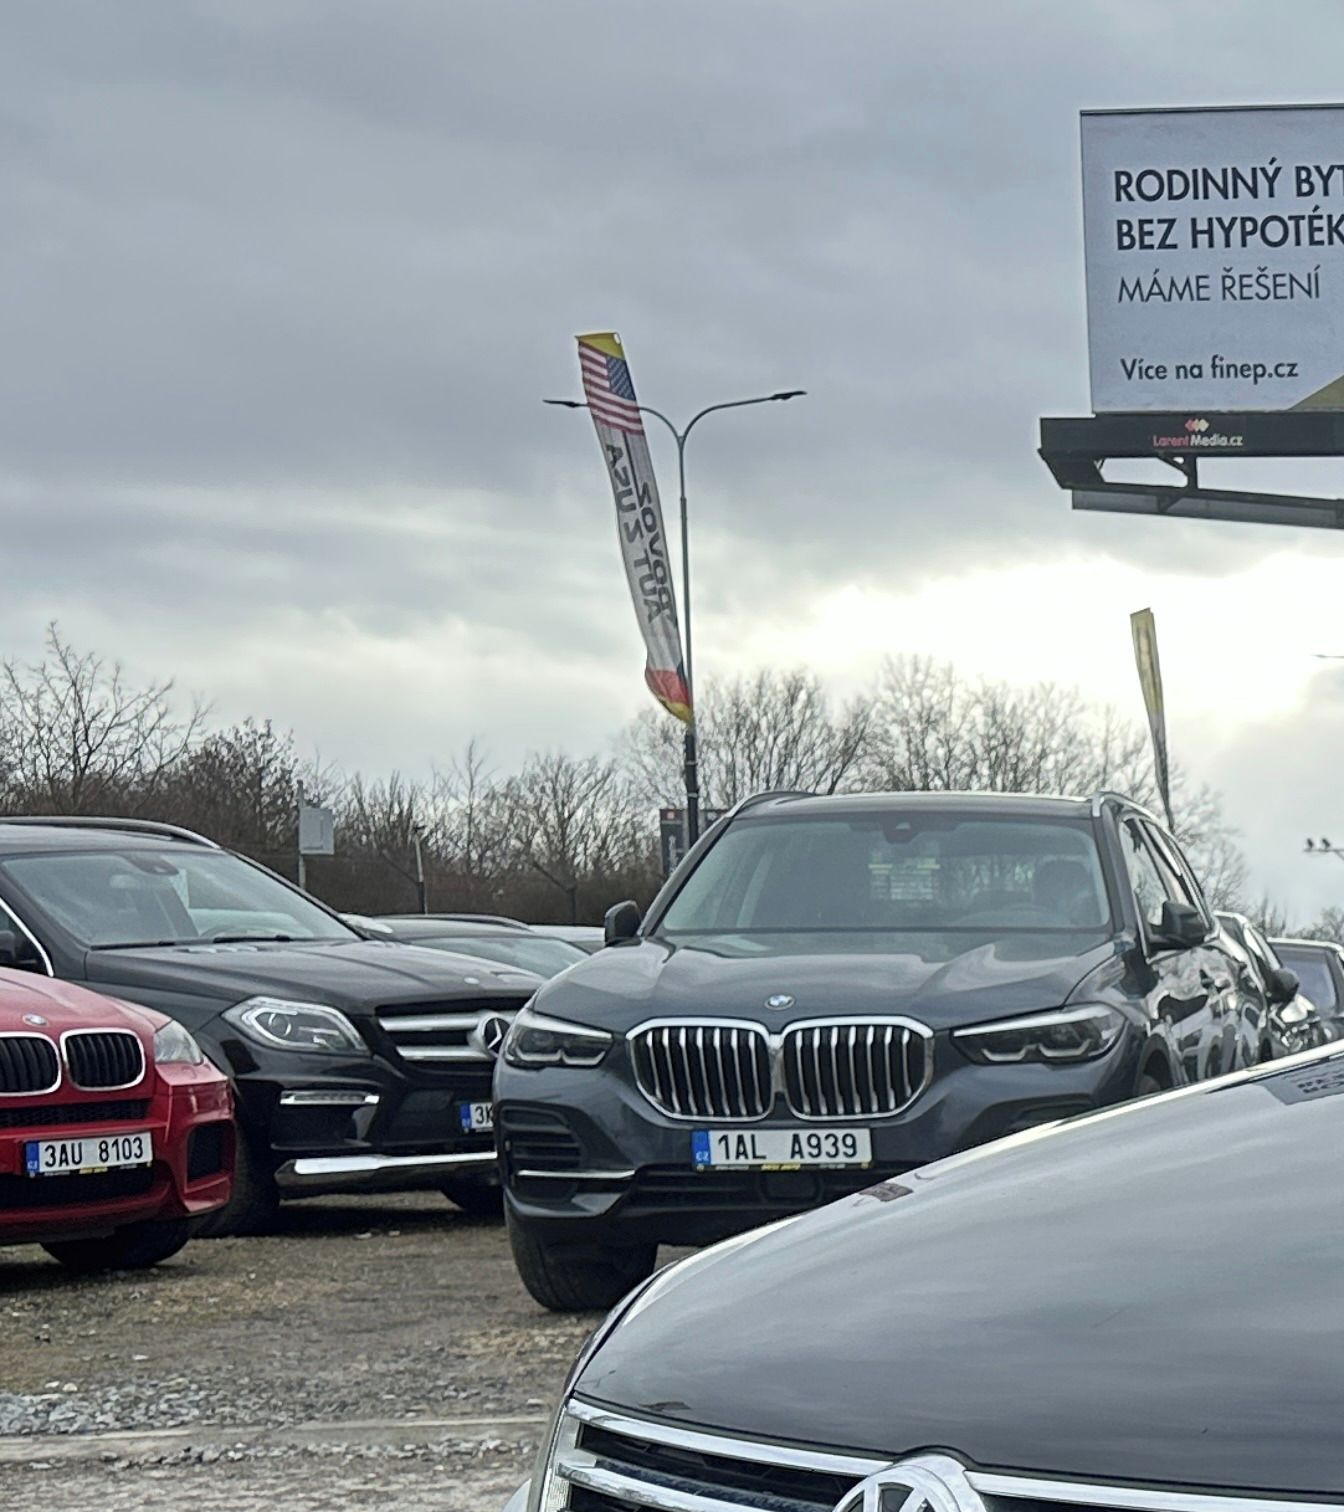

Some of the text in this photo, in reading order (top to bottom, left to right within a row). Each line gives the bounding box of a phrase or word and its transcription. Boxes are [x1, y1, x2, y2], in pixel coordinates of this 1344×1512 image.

[1113, 156, 1282, 202] RODINNÝ
[1116, 217, 1178, 251] BEZ
[1118, 264, 1321, 303] MÁME ŘEŠENÍ
[1120, 353, 1299, 386] Více na finep.cz
[44, 1141, 83, 1168] 3AU
[98, 1136, 144, 1163] 8103
[718, 1133, 767, 1160] 1AL
[790, 1132, 858, 1160] A939
